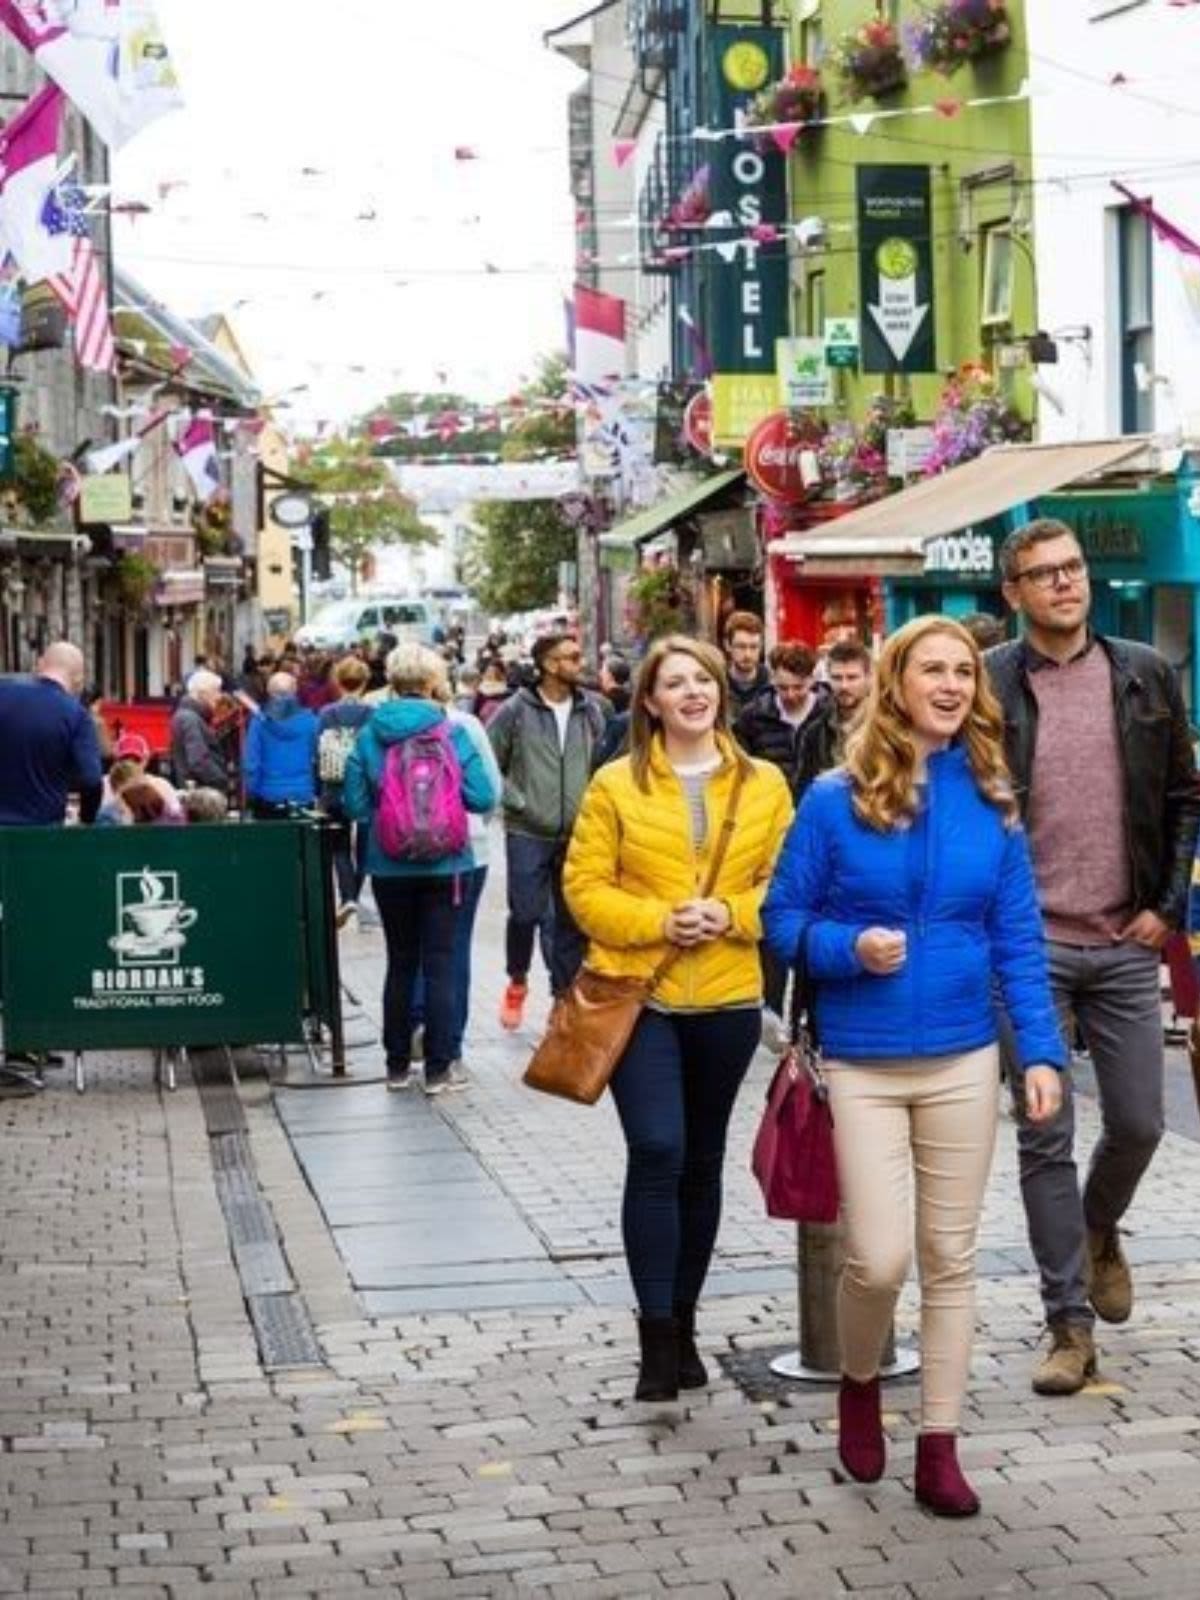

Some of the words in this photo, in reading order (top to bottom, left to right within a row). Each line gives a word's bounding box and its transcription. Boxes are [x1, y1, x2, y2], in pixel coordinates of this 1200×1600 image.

[91, 966, 204, 989] RIORDAN'S
[73, 995, 151, 1009] TRADITIONAL
[154, 995, 185, 1007] IRISH
[188, 993, 224, 1006] FOOD
